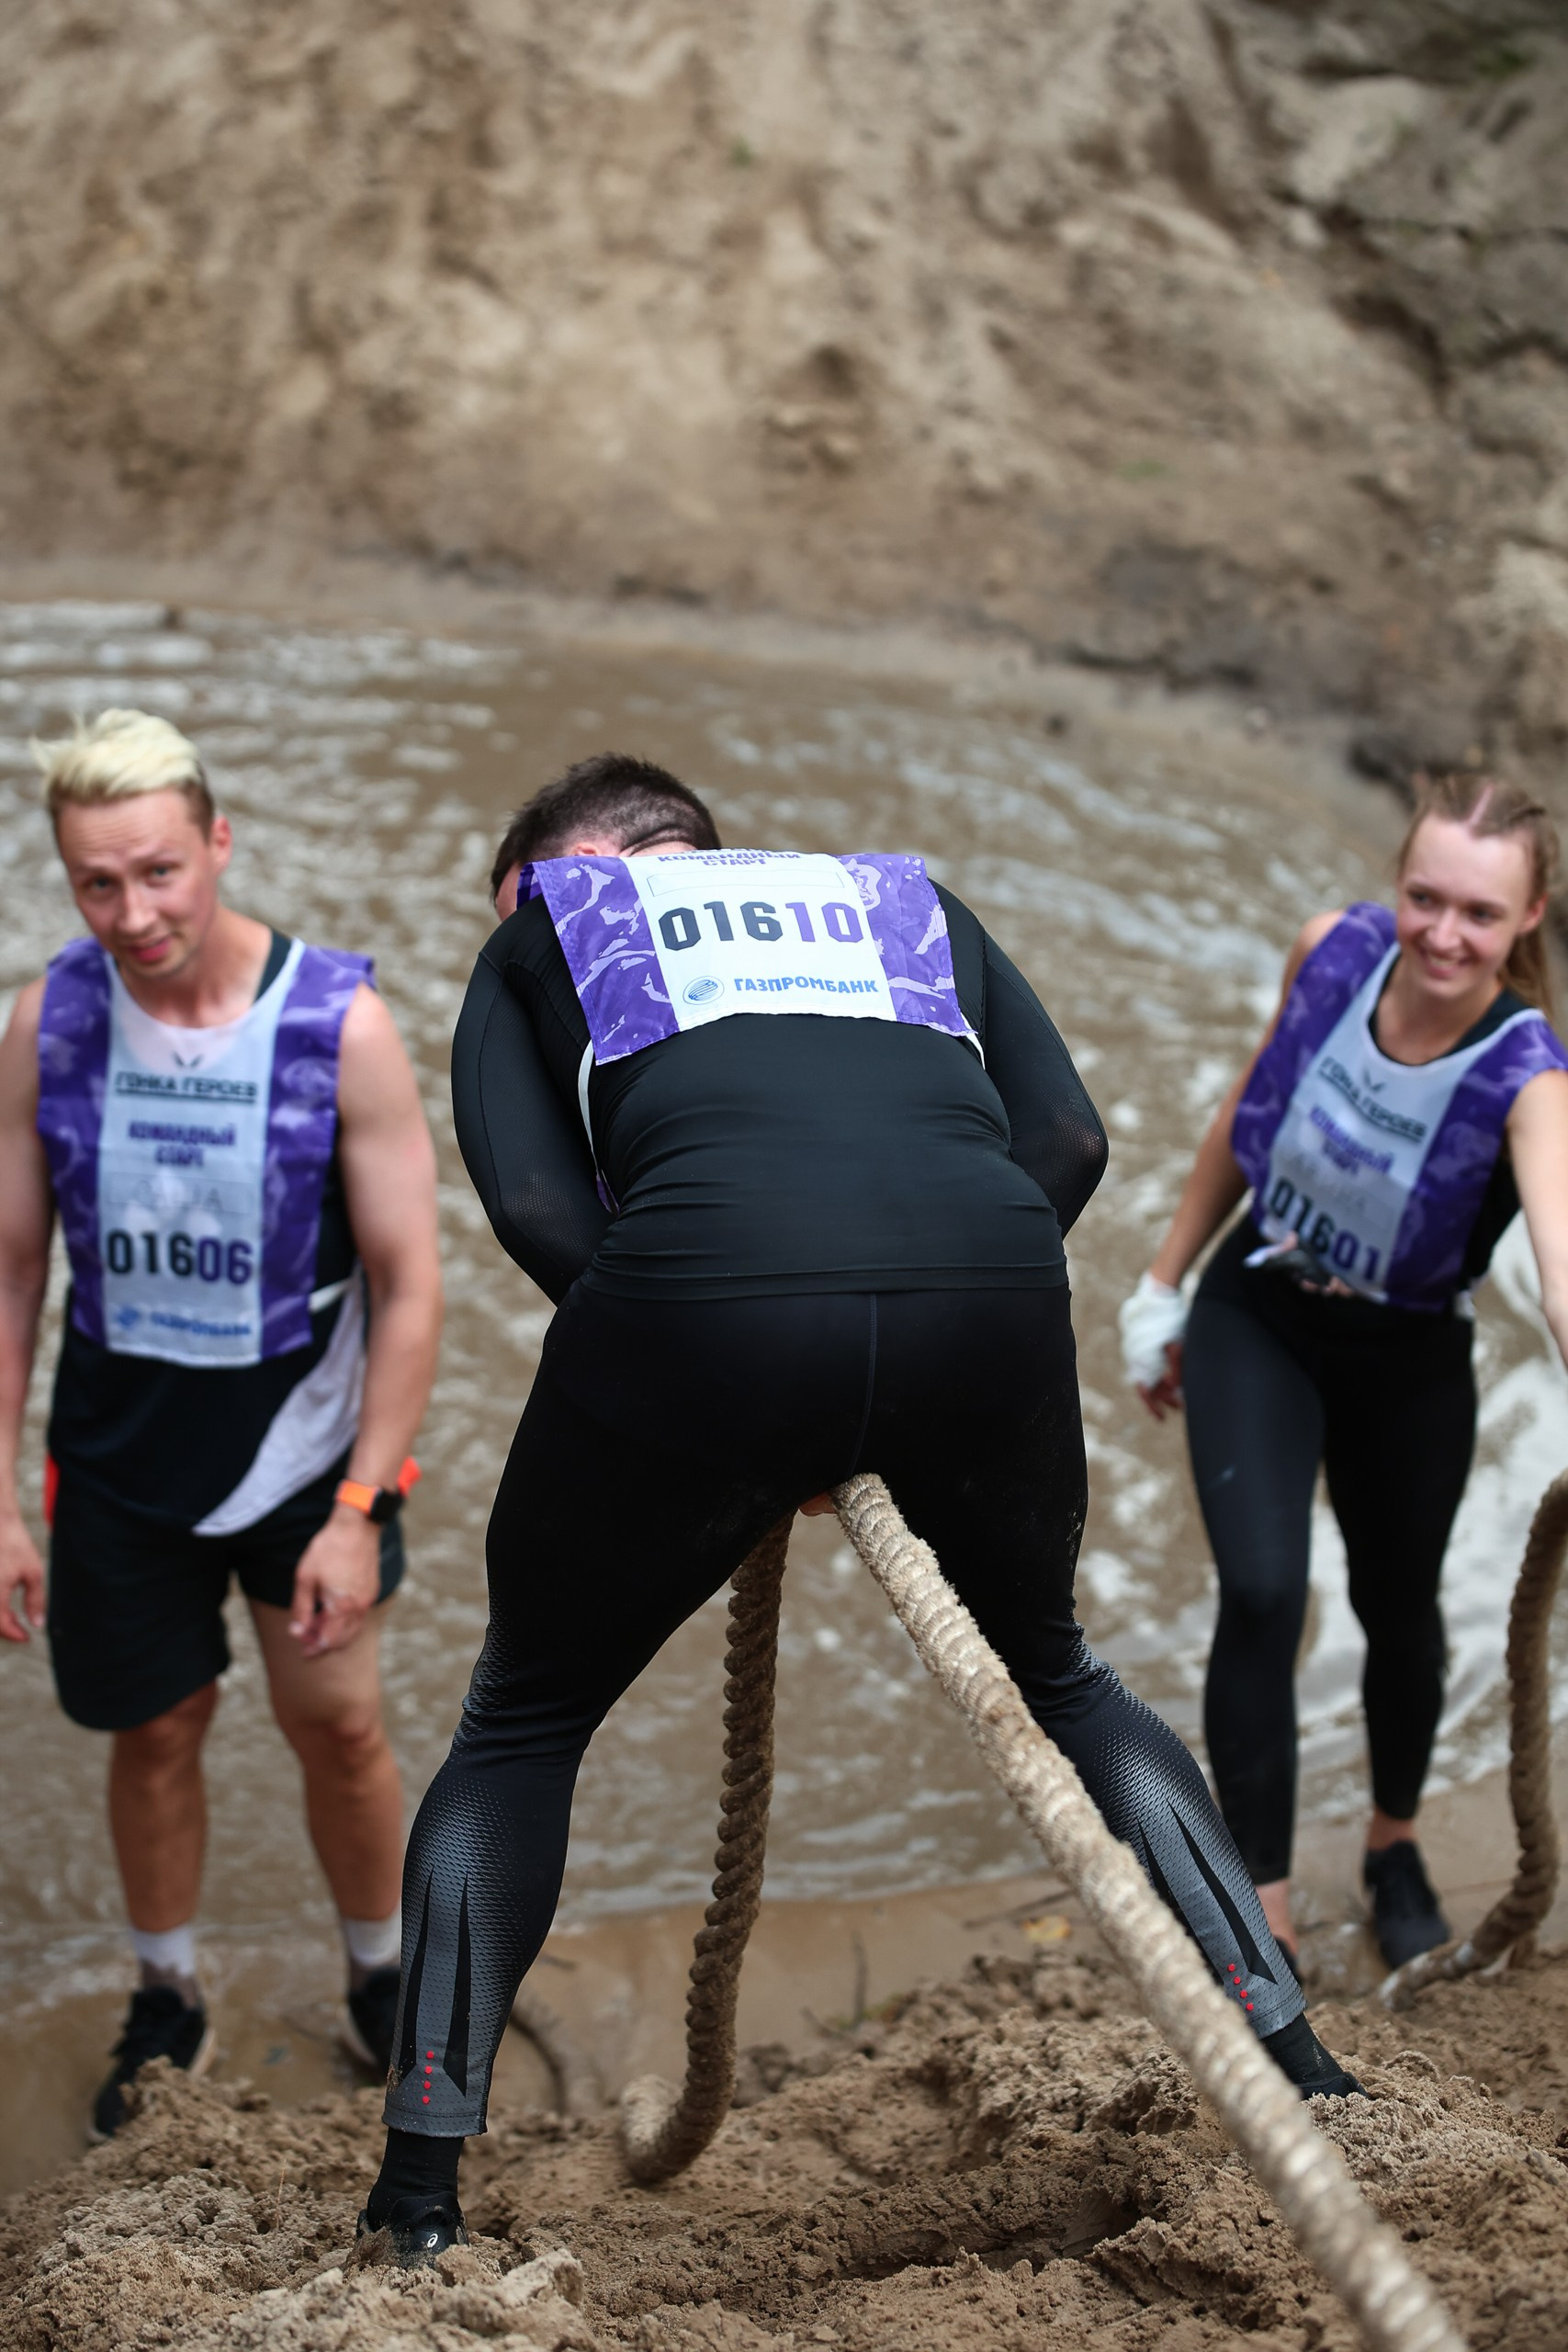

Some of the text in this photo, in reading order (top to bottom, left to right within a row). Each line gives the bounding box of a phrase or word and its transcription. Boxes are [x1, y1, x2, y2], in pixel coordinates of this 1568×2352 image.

[703, 857, 766, 866] СТАРТ
[659, 900, 864, 952] 01610
[734, 976, 879, 994] ГАЗПРОМБАНК
[1269, 1176, 1382, 1282] 01601
[106, 1228, 254, 1286] 01606
